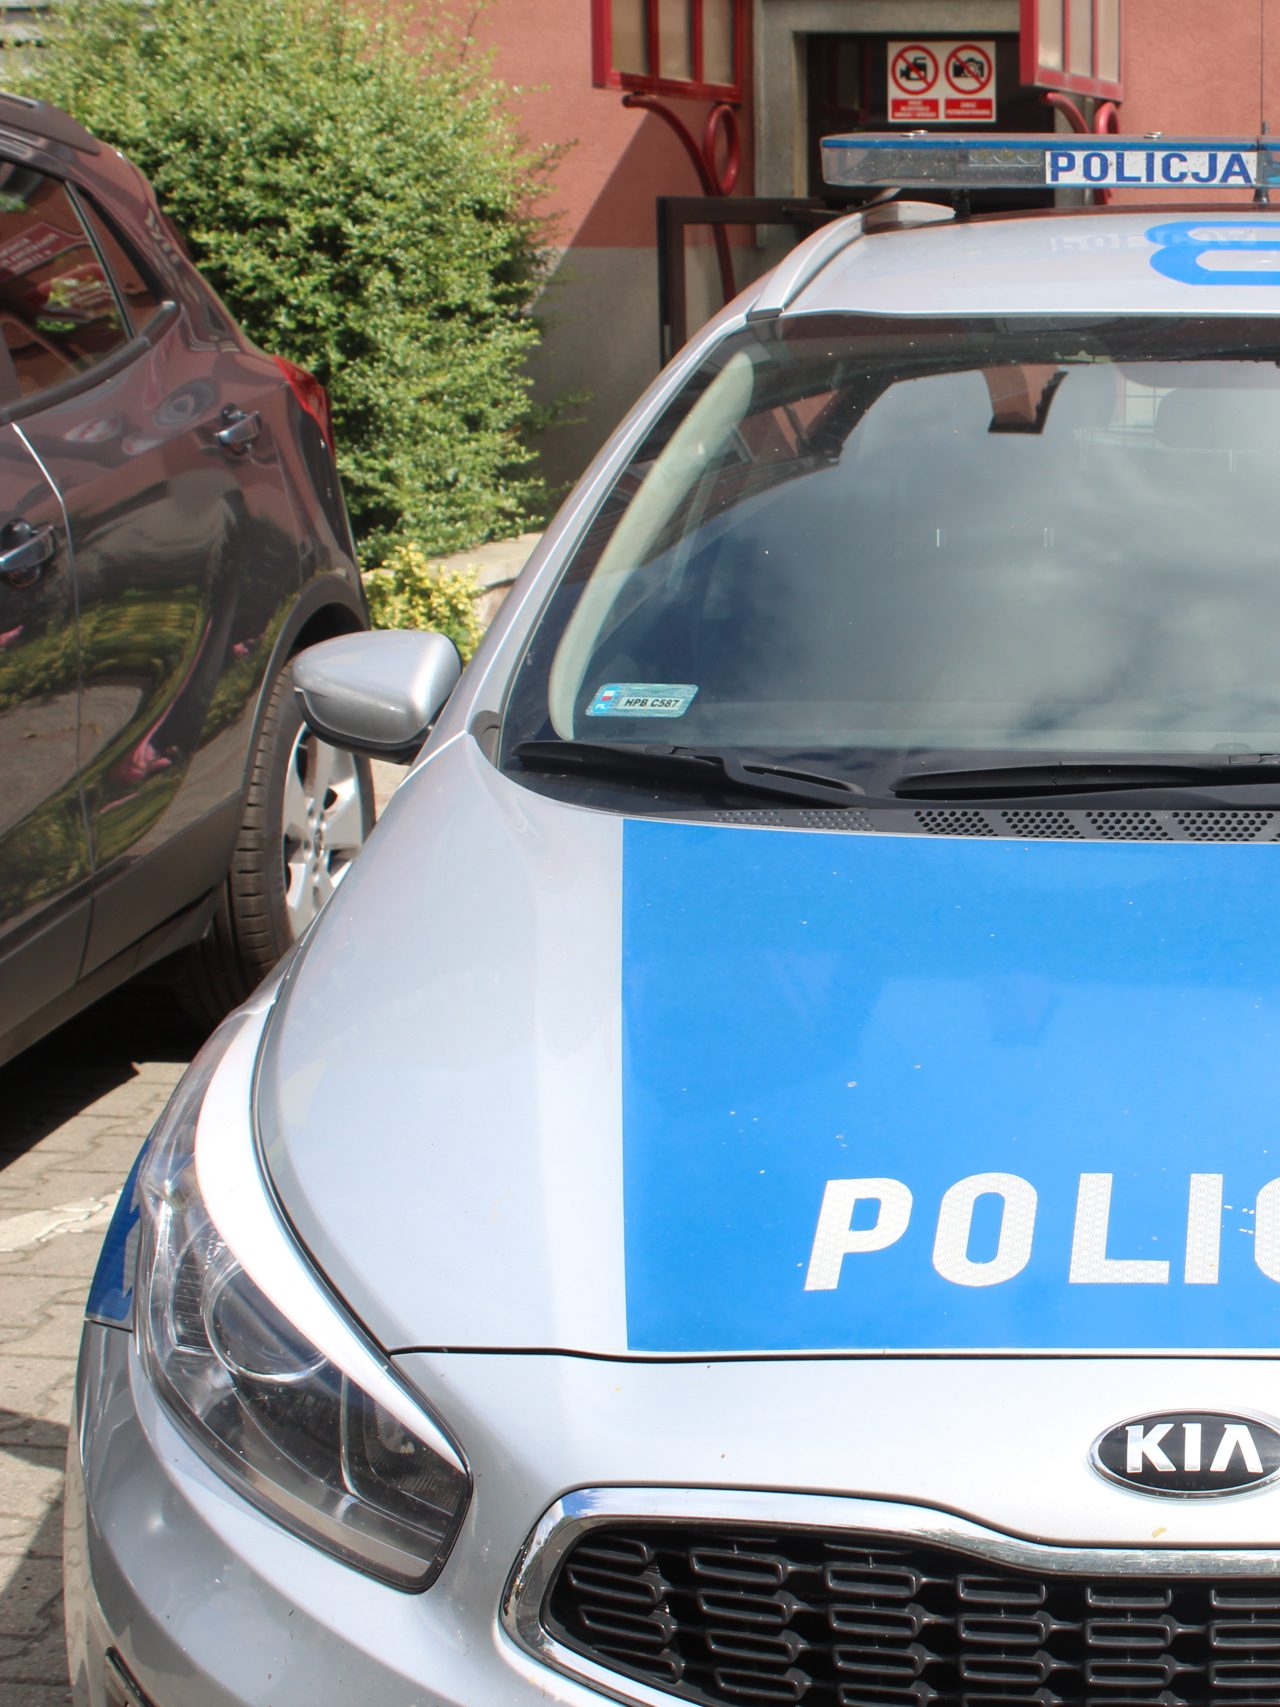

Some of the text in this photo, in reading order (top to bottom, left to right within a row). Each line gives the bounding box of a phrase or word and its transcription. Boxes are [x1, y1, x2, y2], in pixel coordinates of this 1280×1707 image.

[1050, 152, 1253, 183] POLICJA
[624, 698, 679, 708] HPB C587
[1125, 1423, 1263, 1473] KIA
